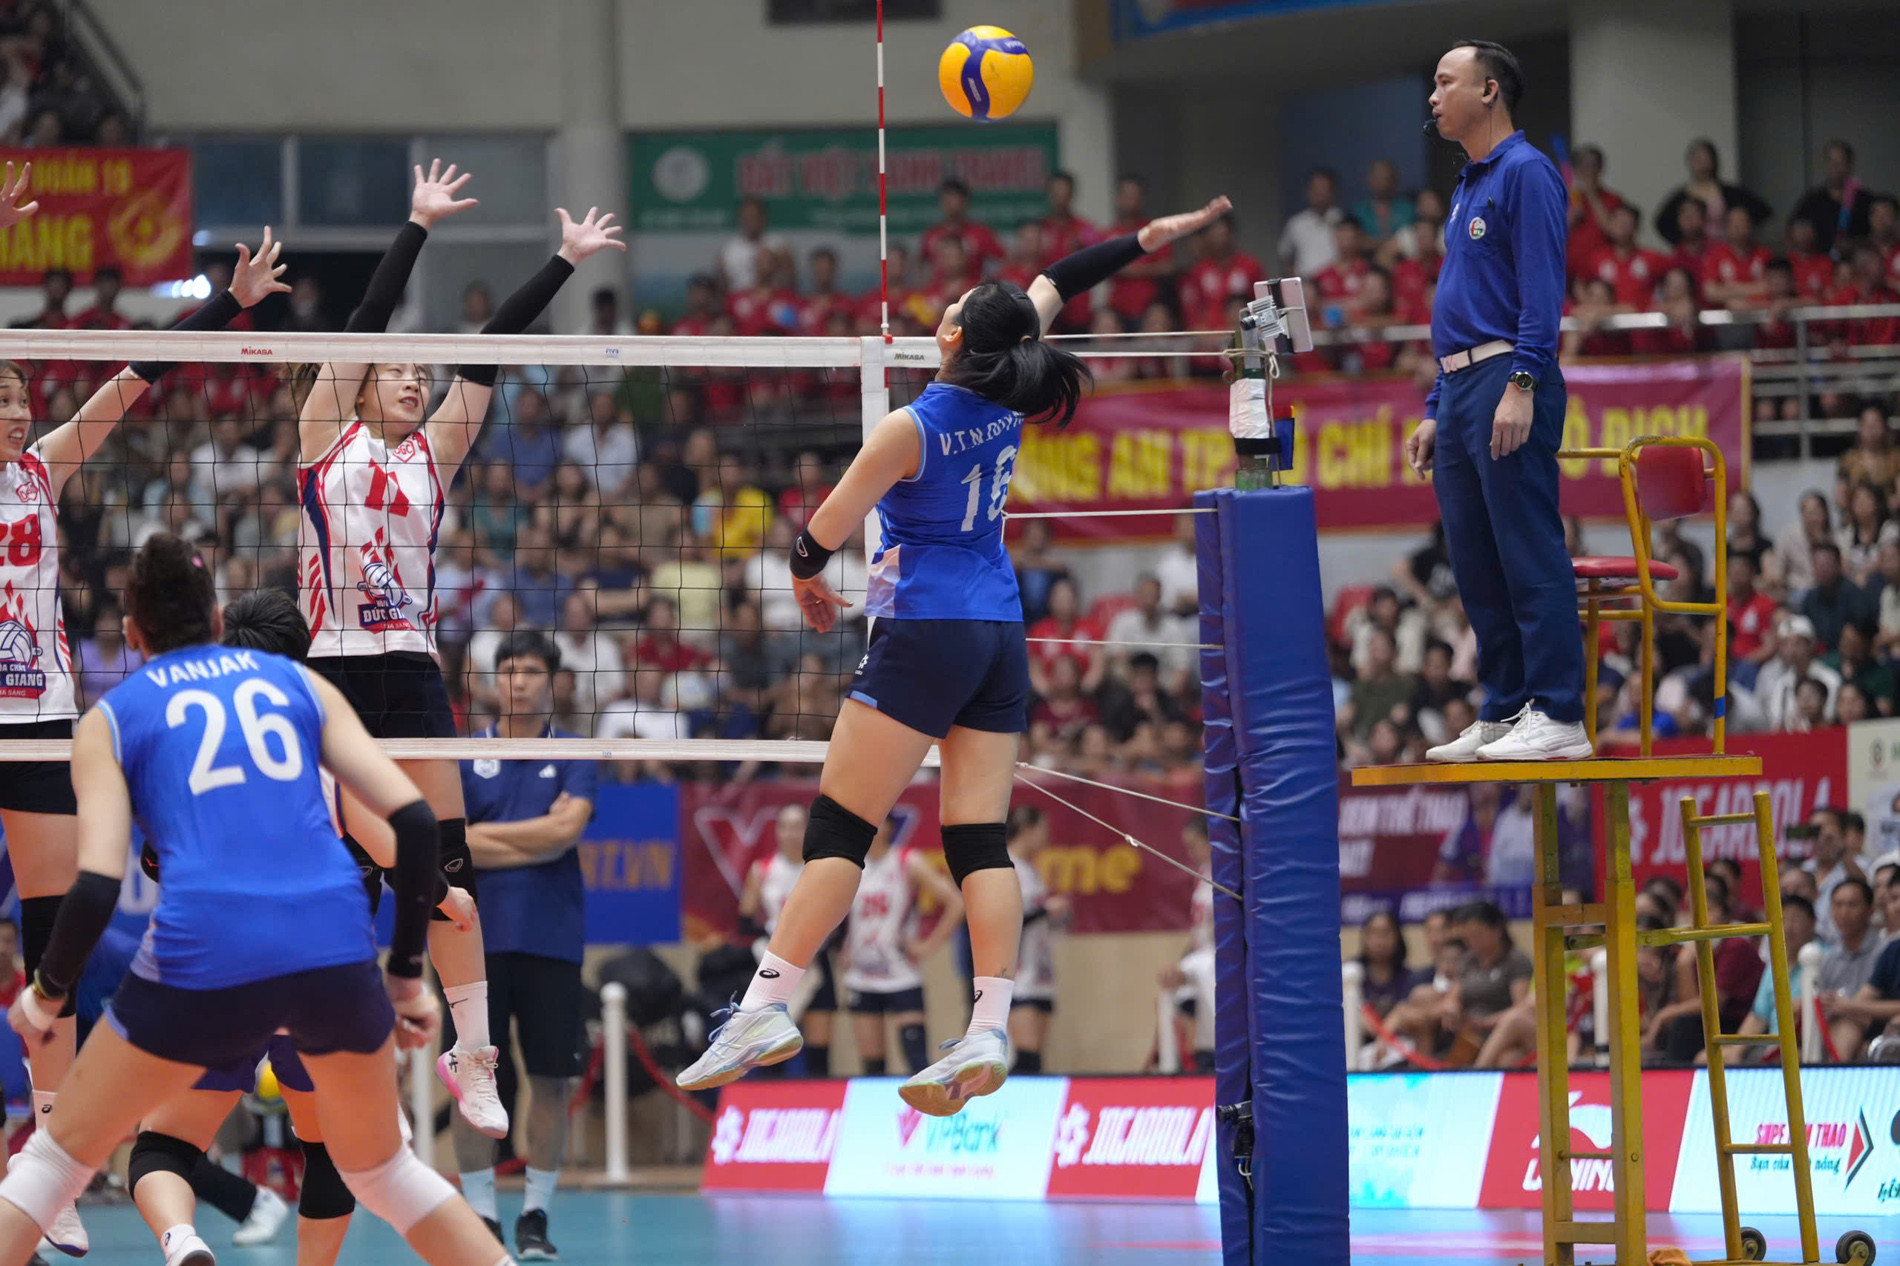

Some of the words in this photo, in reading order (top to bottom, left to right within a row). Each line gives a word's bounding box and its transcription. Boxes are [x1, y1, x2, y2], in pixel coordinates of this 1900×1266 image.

[364, 457, 410, 518] 11
[5, 673, 43, 687] GIANG
[146, 651, 260, 688] VANJAK
[165, 678, 303, 795] 26
